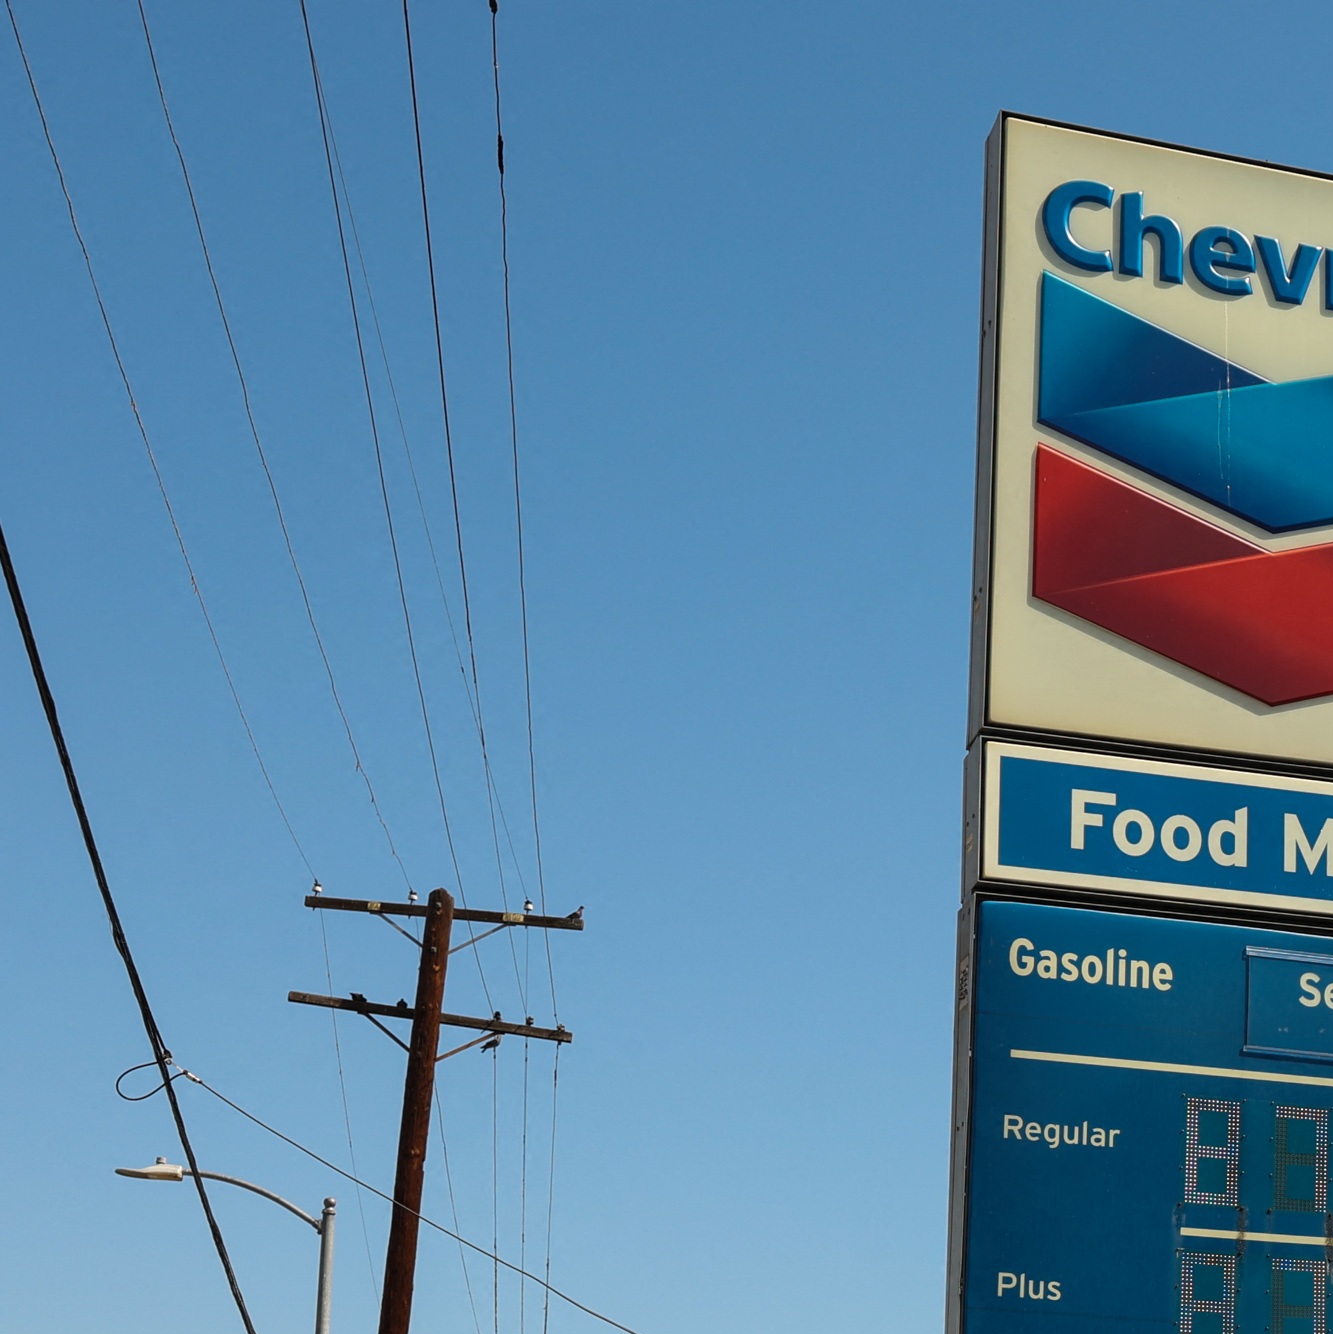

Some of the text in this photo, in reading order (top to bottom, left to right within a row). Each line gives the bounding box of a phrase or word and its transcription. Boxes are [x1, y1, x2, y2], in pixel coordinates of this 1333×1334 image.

[1069, 787, 1249, 869] Food
[1008, 938, 1174, 992] Gasoline
[1002, 1114, 1121, 1150] Regular
[996, 1271, 1062, 1302] Plus
